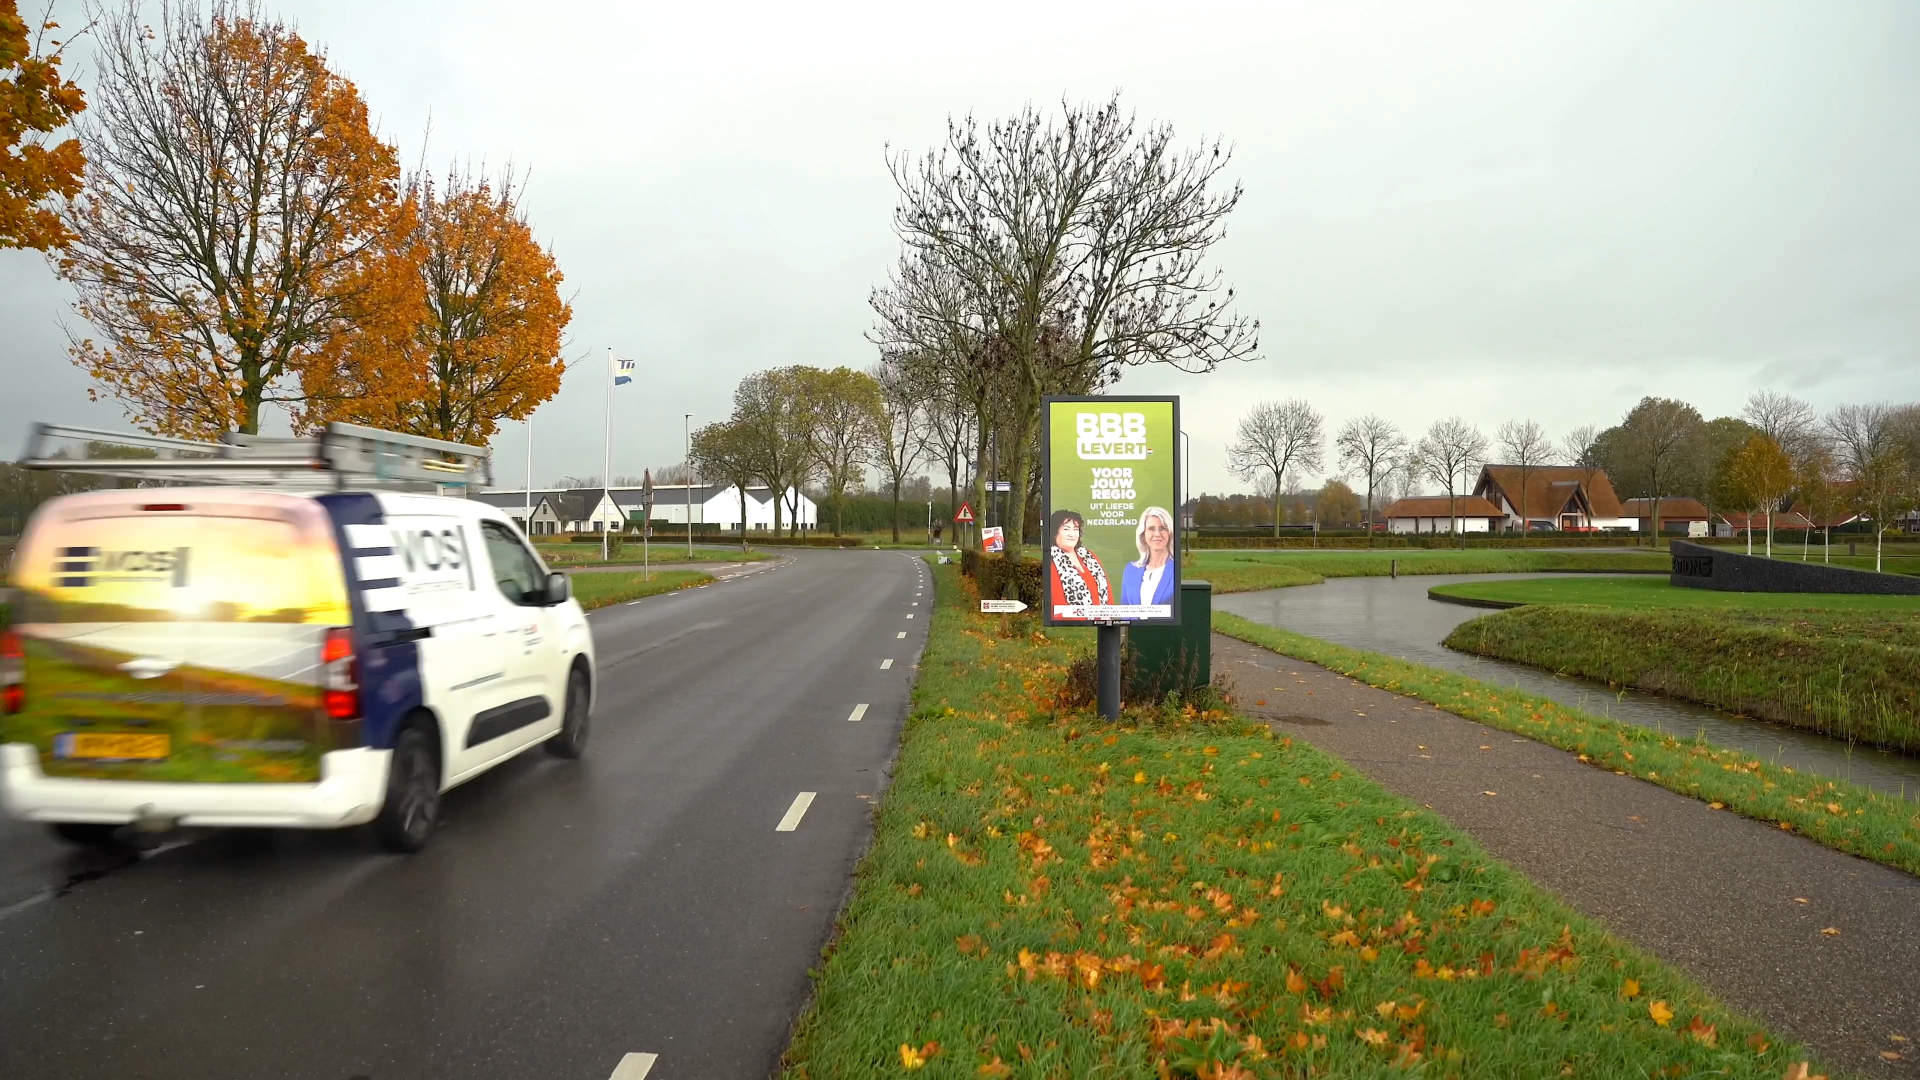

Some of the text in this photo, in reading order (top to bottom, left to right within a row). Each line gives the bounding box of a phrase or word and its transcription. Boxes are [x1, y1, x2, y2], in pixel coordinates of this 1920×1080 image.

[1077, 413, 1146, 438] BBB
[1081, 443, 1146, 455] LEVERT
[1091, 467, 1133, 478] VOOR
[1090, 478, 1134, 489] JOUW
[1092, 488, 1136, 500] REGIO
[390, 529, 462, 572] VOS
[98, 550, 177, 572] VOS
